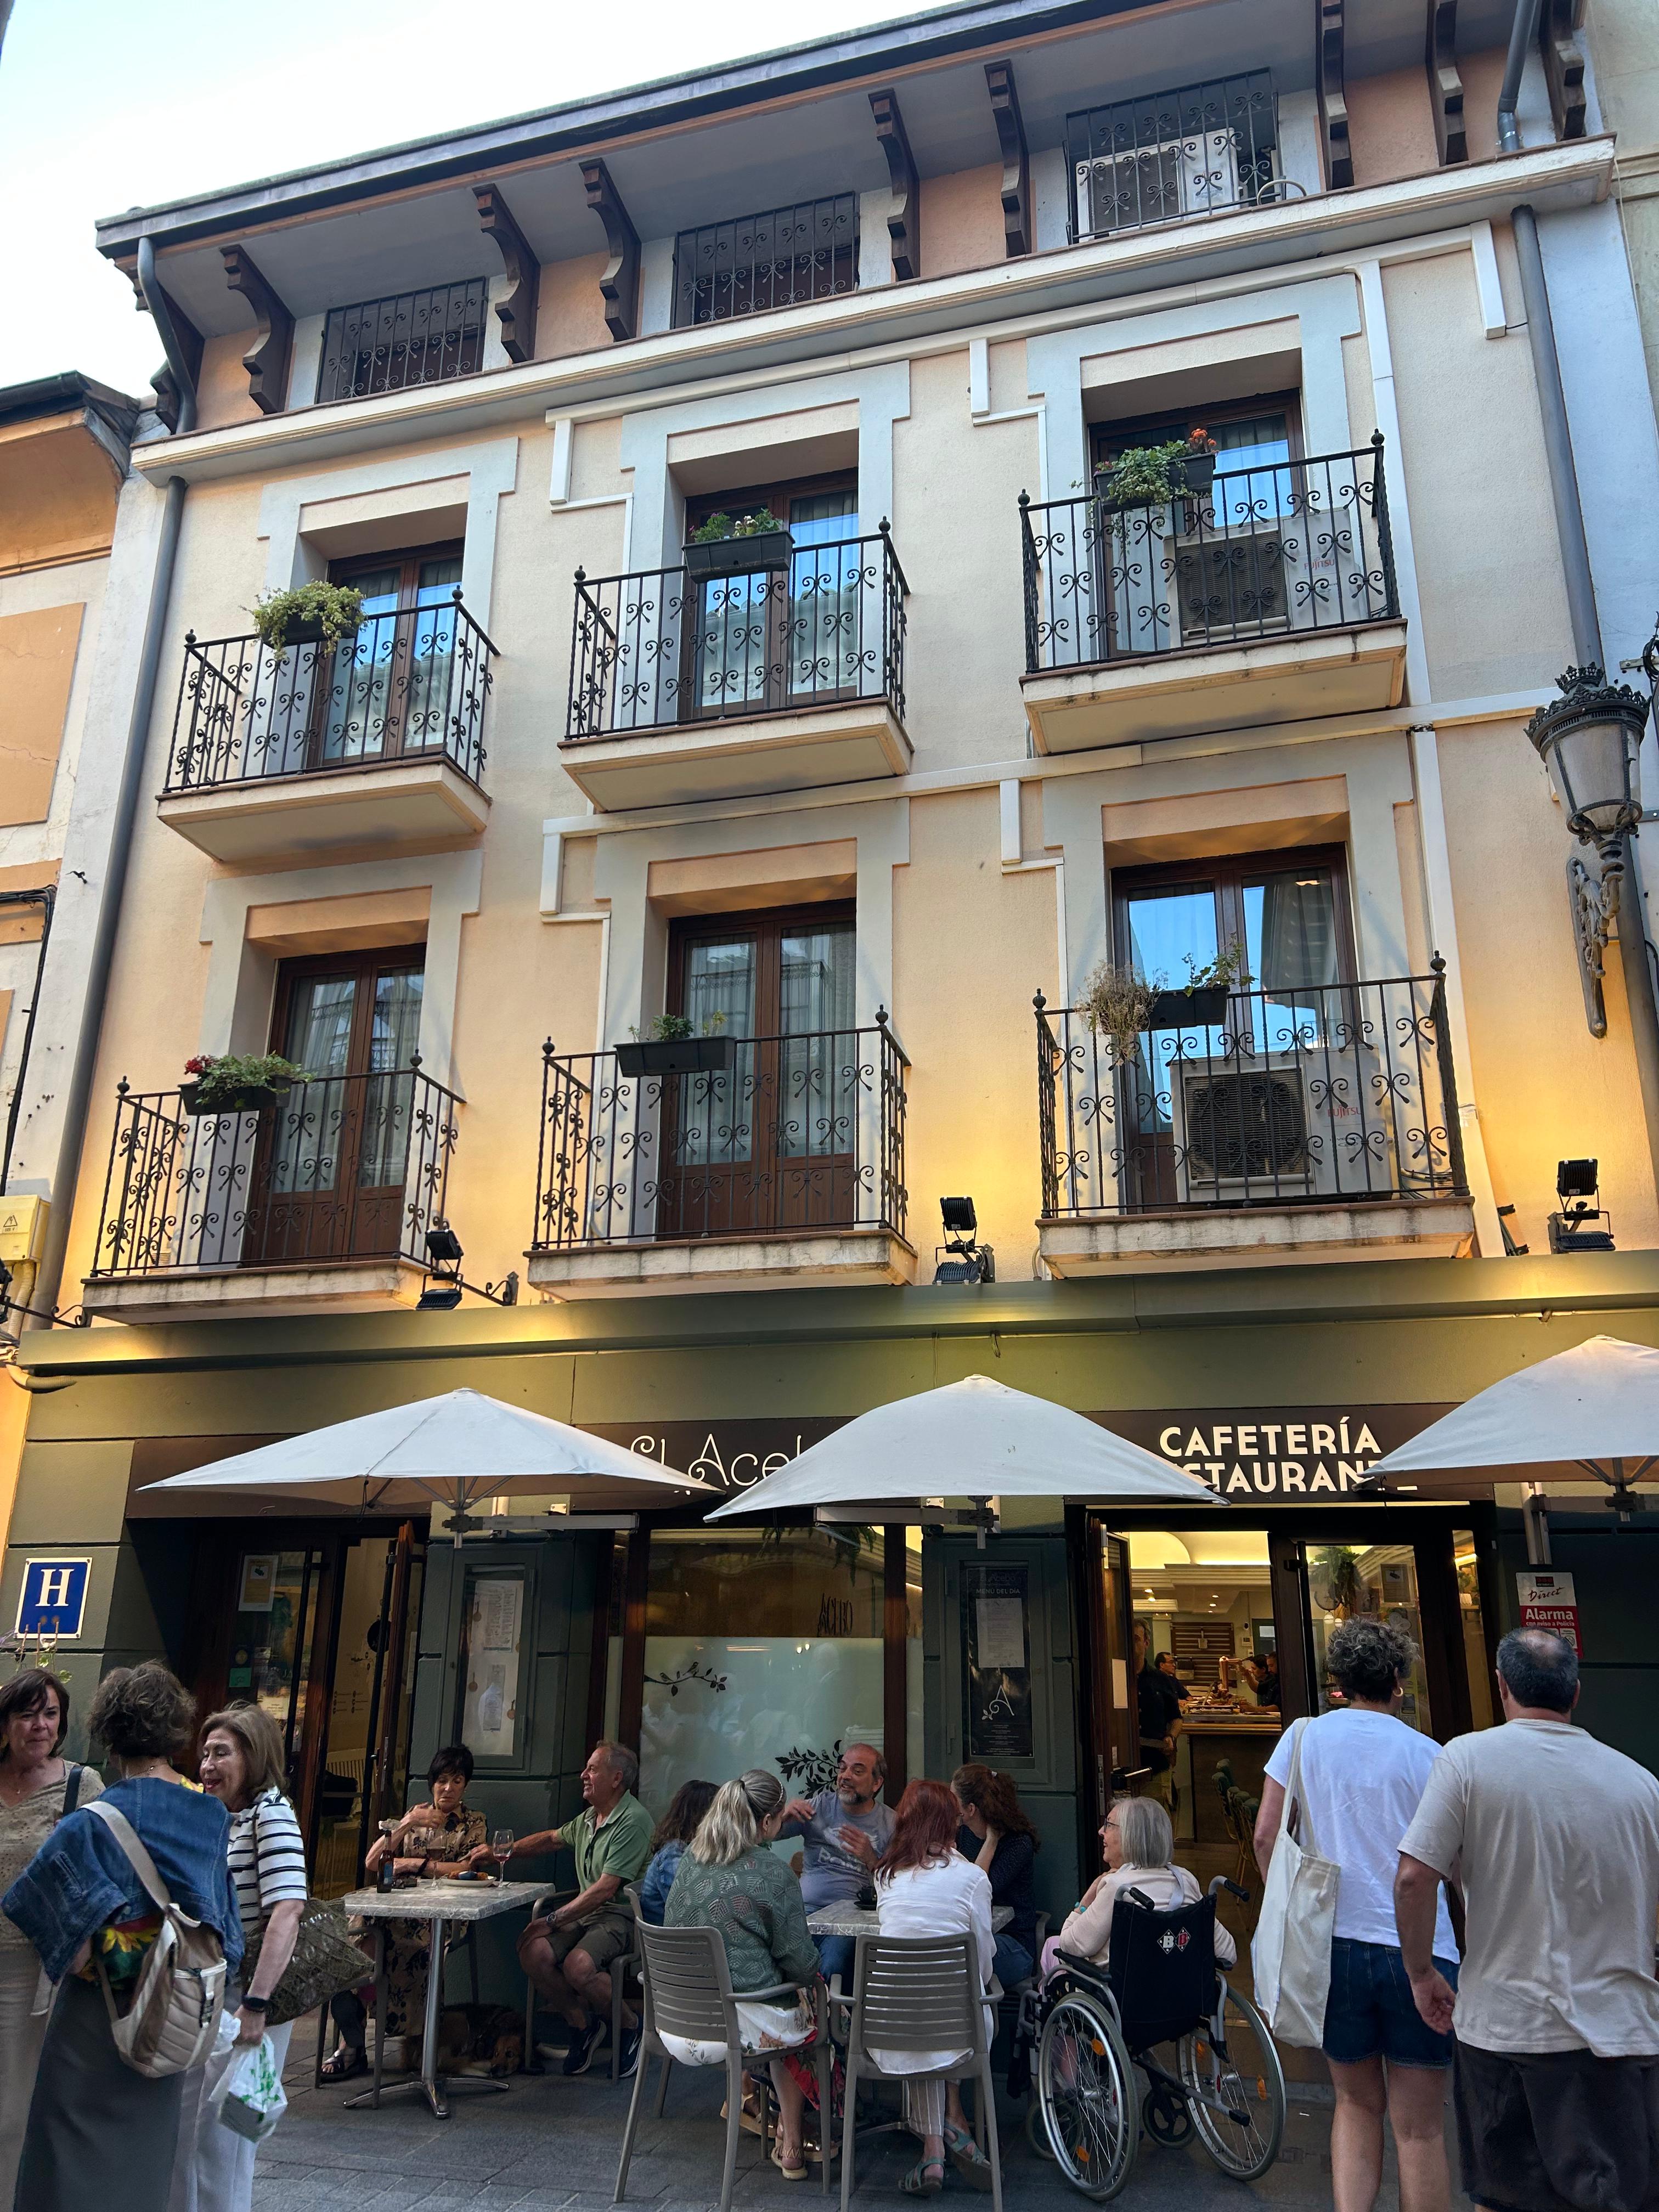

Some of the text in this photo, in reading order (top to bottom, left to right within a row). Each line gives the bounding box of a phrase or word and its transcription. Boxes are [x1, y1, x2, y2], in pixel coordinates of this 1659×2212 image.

[1159, 1416, 1381, 1457] CAFETERÍA
[688, 1434, 802, 1486] Ace
[1173, 1461, 1418, 1493] TAURAN
[35, 1568, 75, 1607] H
[1528, 1587, 1566, 1602] Direct
[1526, 1608, 1574, 1620] Alarma
